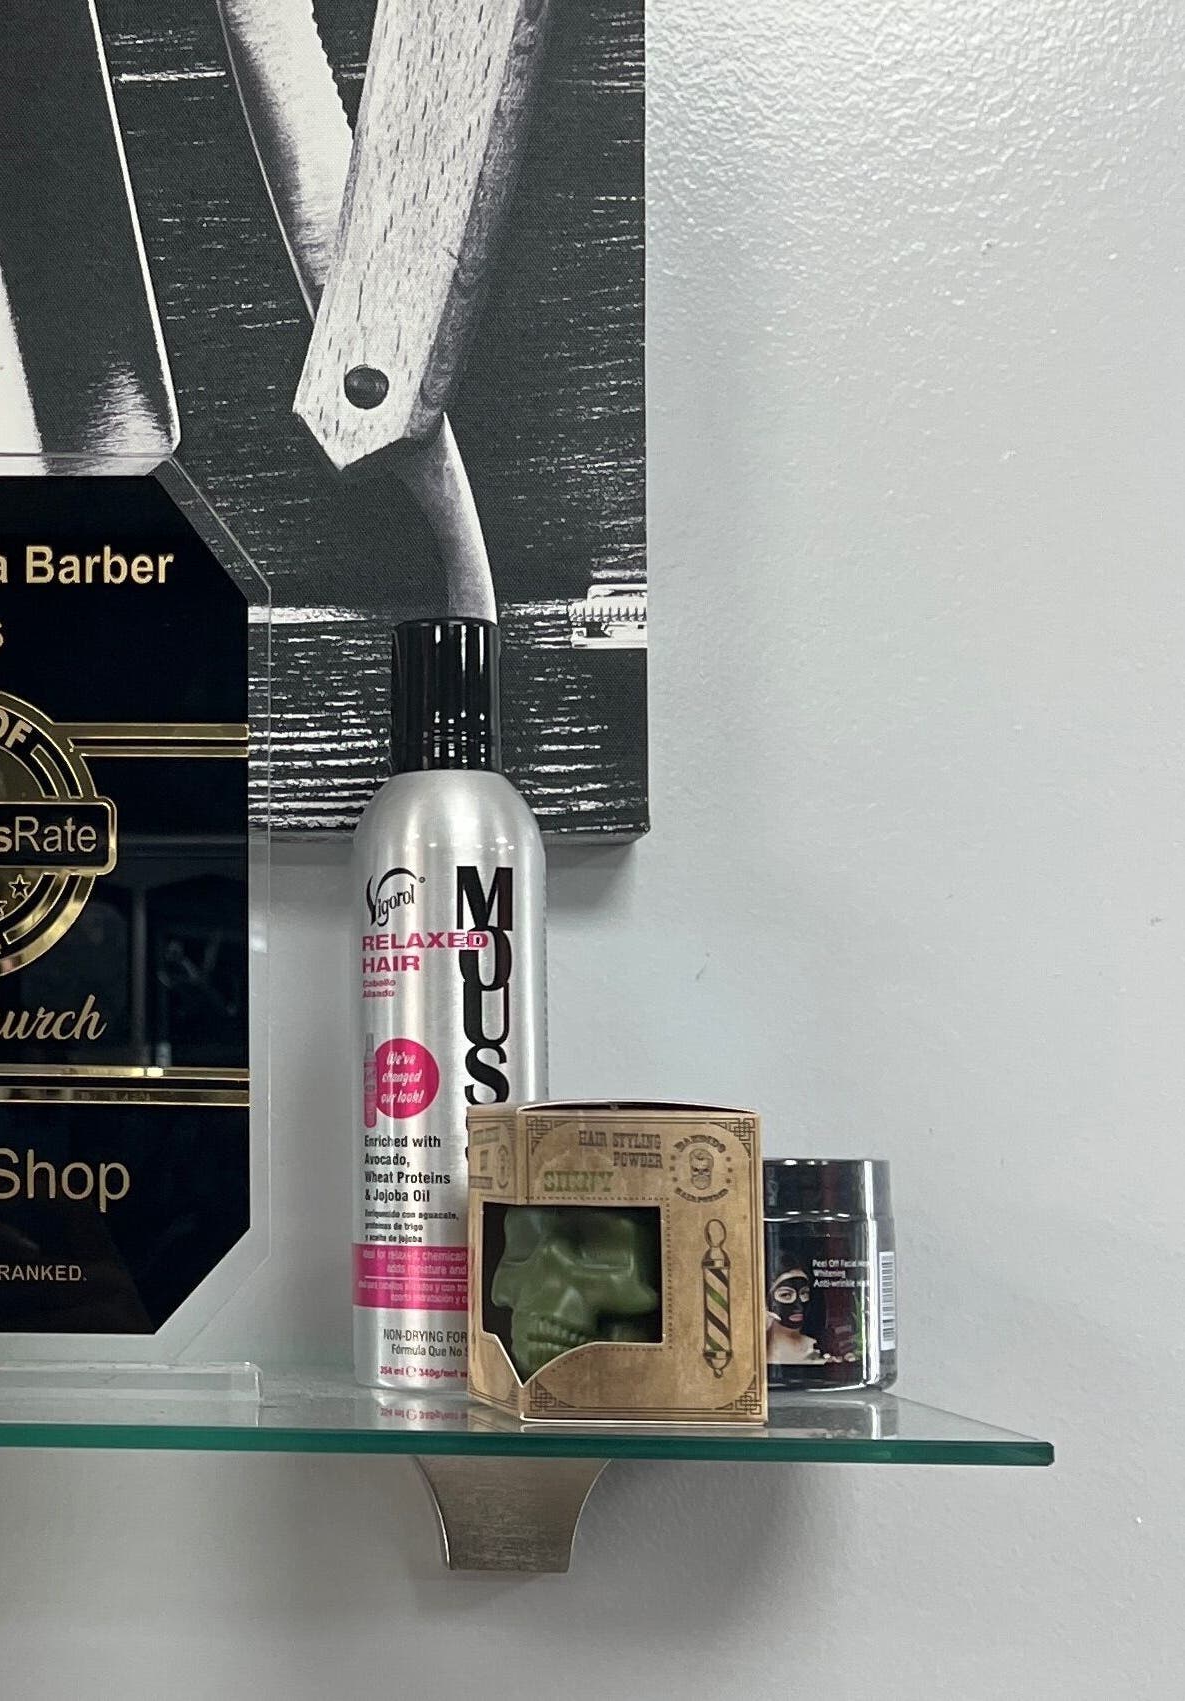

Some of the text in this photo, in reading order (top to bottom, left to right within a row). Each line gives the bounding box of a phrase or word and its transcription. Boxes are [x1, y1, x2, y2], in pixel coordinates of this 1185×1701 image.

[25, 545, 175, 584] Barber
[362, 932, 489, 951] RELAXED
[362, 955, 421, 973] HAIR
[364, 1134, 442, 1148] Enriched with
[578, 1130, 662, 1150] HAIR STYLING
[364, 1152, 411, 1168] Avocado,
[613, 1151, 663, 1169] POWDER
[397, 1171, 451, 1184] Proteins
[372, 1188, 409, 1204] Jojoba
[413, 1189, 431, 1202] Oil
[383, 1328, 444, 1343] NON-DRYING
[428, 1345, 447, 1357] Que
[449, 1346, 463, 1357] No
